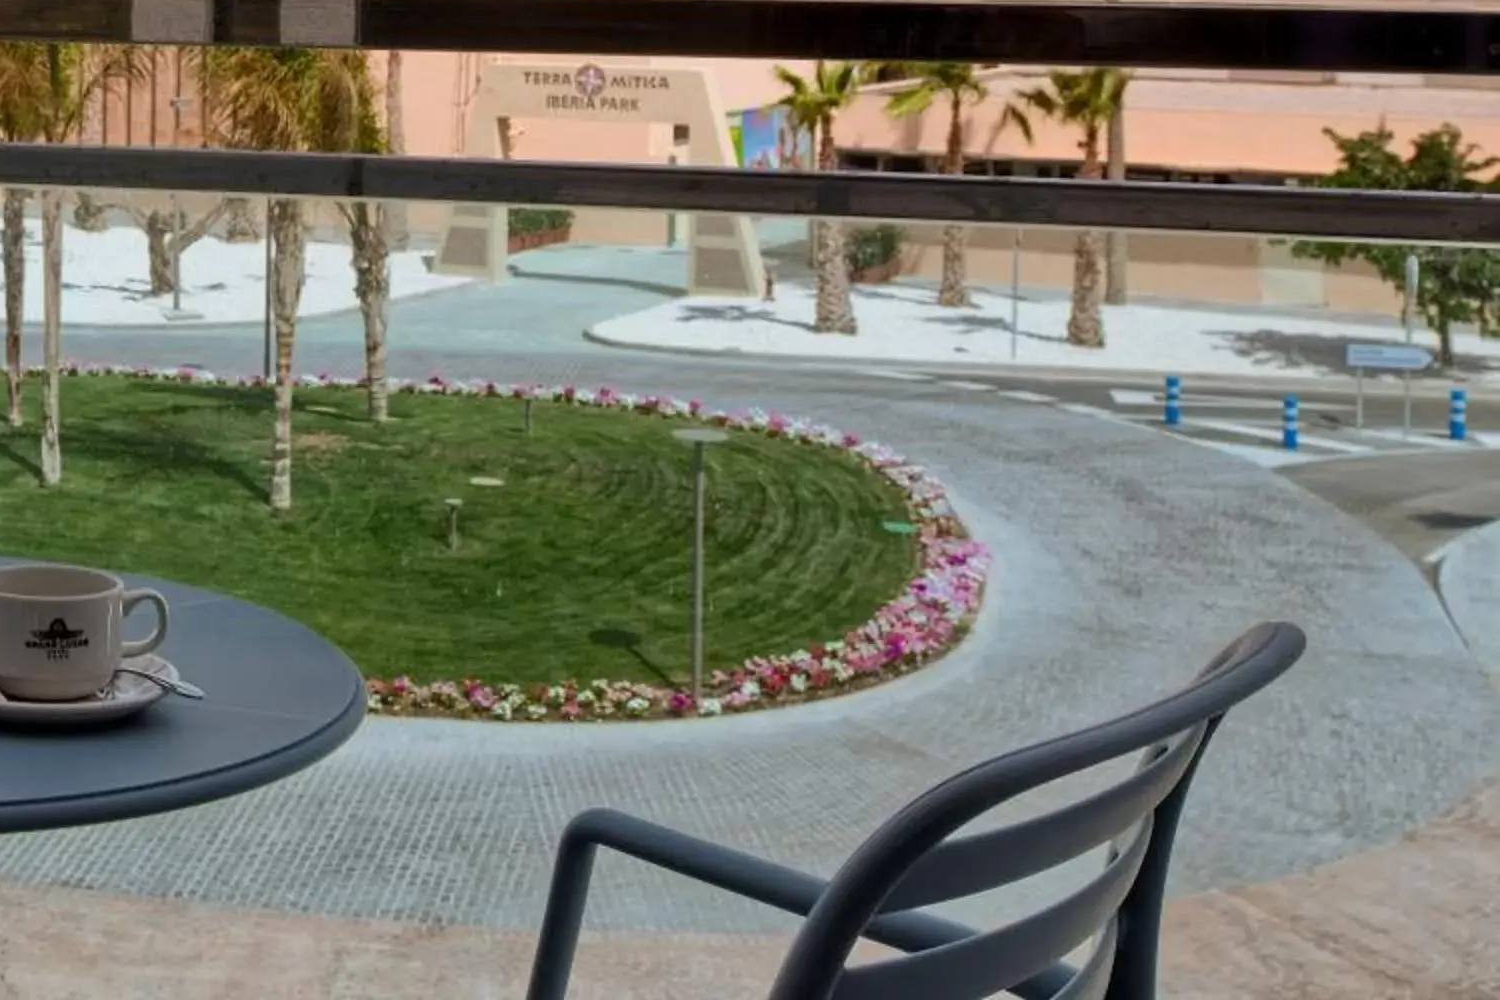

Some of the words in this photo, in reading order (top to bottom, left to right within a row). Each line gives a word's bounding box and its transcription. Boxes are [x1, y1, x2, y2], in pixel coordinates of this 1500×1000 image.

[523, 71, 572, 86] TERRA
[546, 95, 596, 110] IBERIA
[600, 96, 640, 111] PARK
